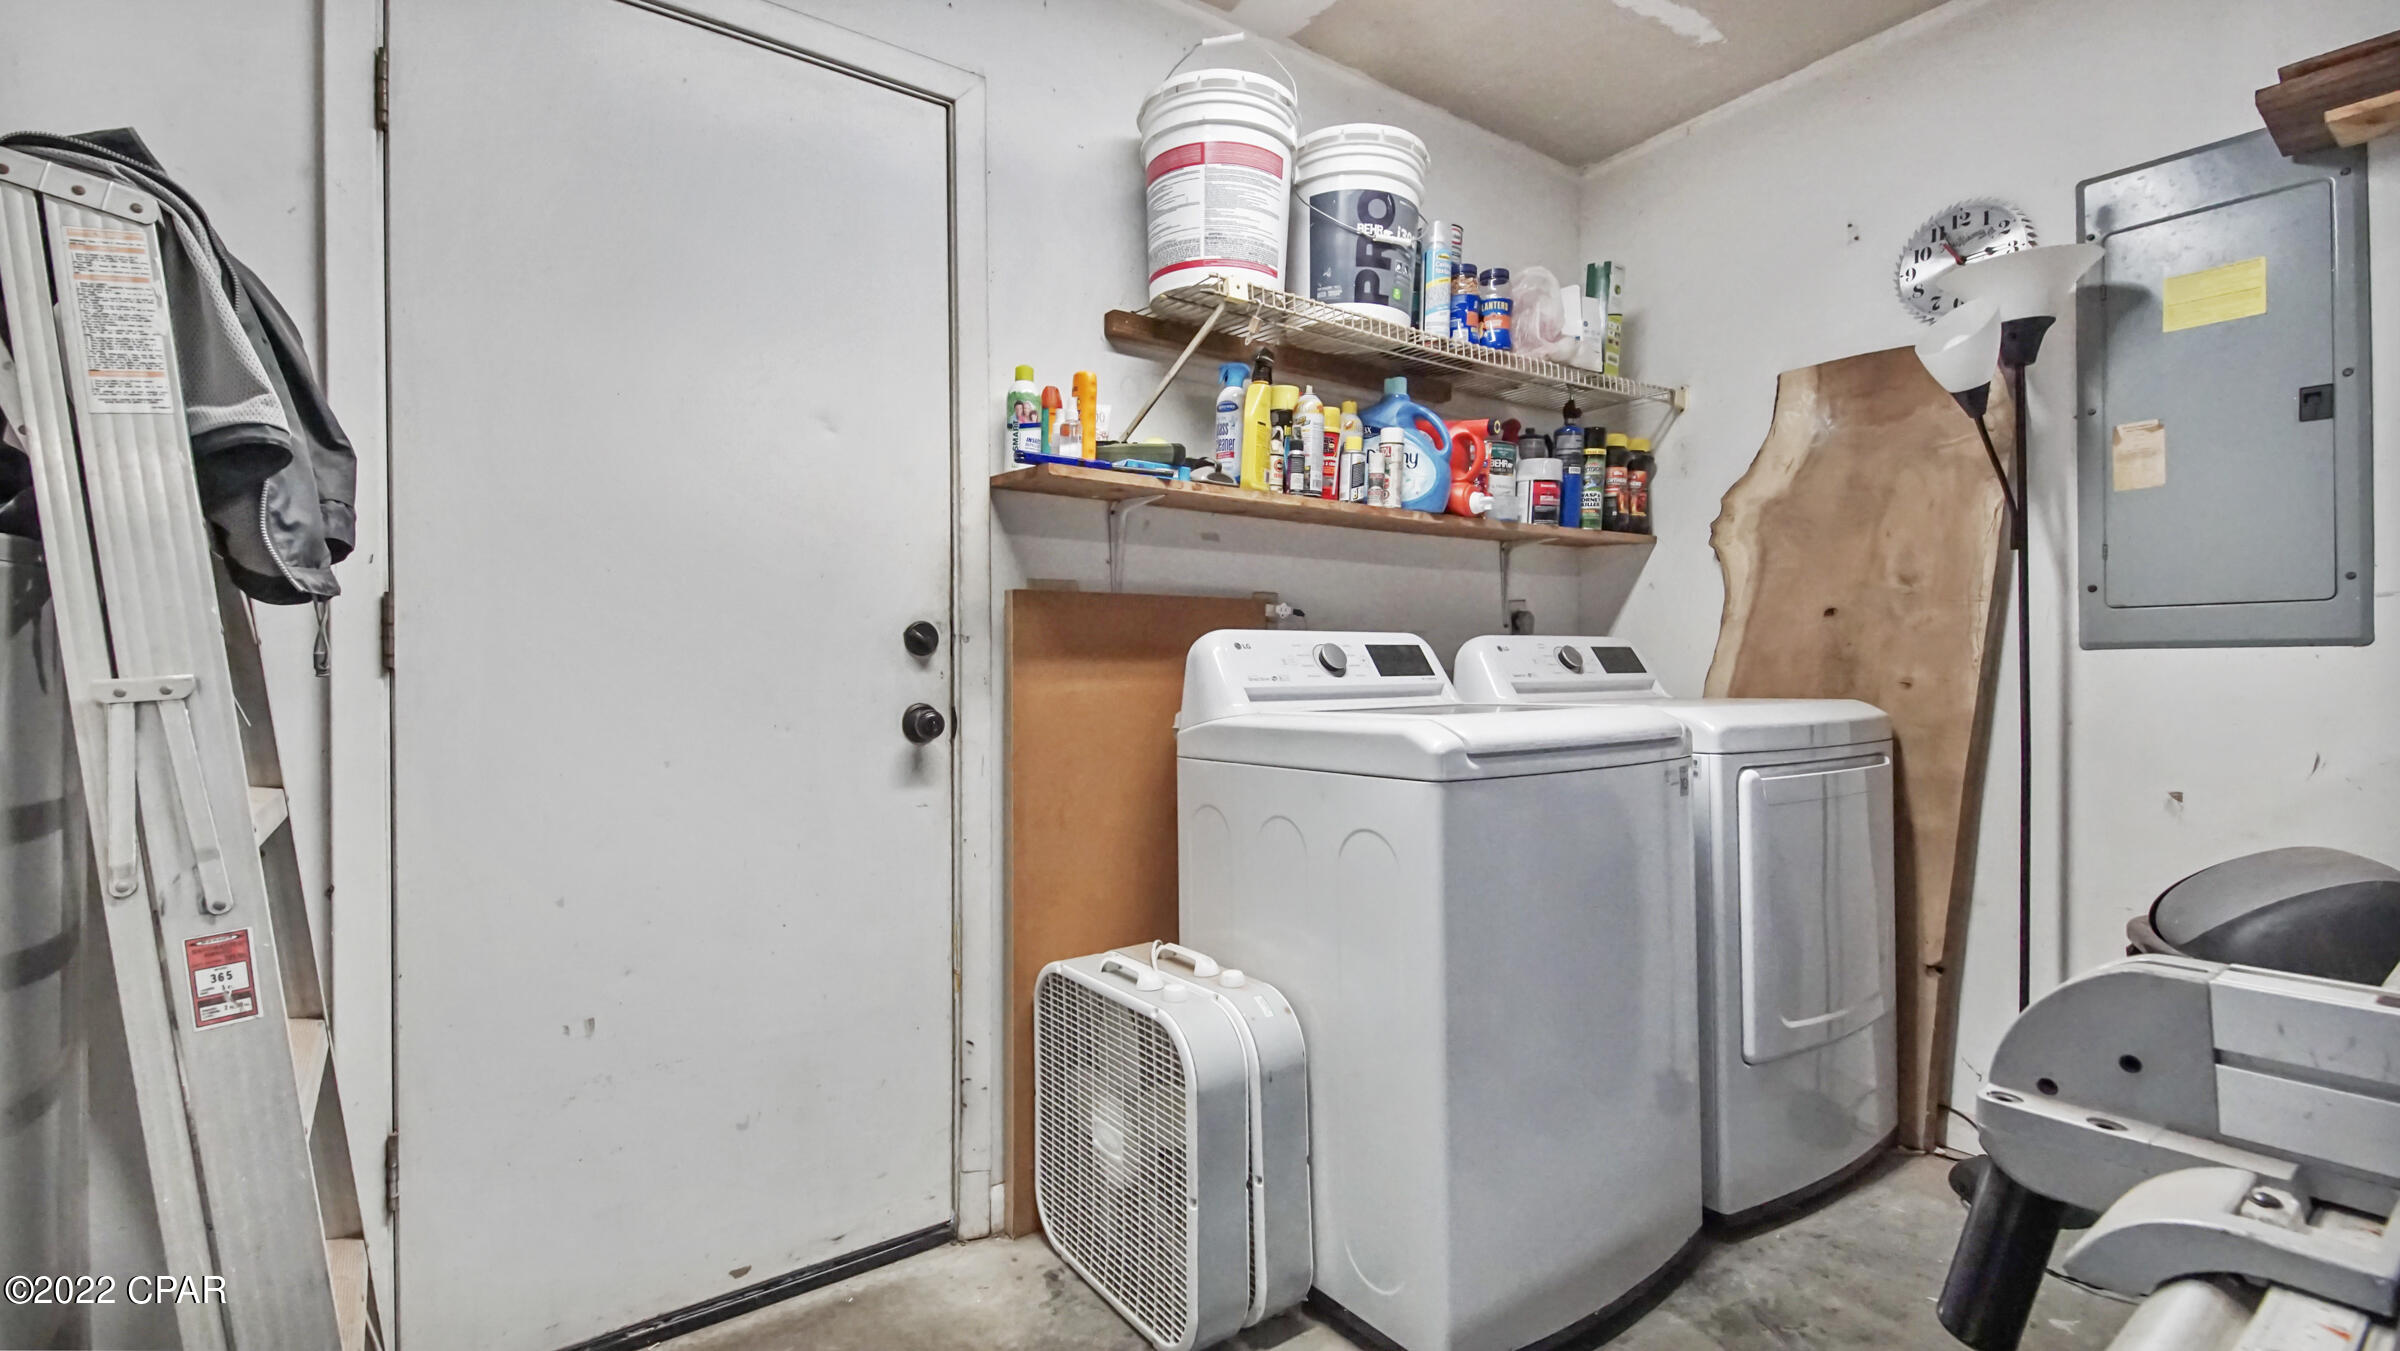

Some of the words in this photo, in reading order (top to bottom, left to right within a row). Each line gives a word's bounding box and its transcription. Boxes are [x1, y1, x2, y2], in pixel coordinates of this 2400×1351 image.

[1952, 211, 1971, 230] 12
[1984, 210, 1990, 226] 1
[1357, 223, 1384, 238] BEHR
[1999, 219, 2011, 234] 2
[1931, 226, 1946, 243] 11
[1354, 189, 1396, 306] PRO
[1914, 247, 1932, 263] 10
[1905, 267, 1917, 282] 9
[1912, 284, 1925, 298] 8
[210, 971, 233, 984] 365
